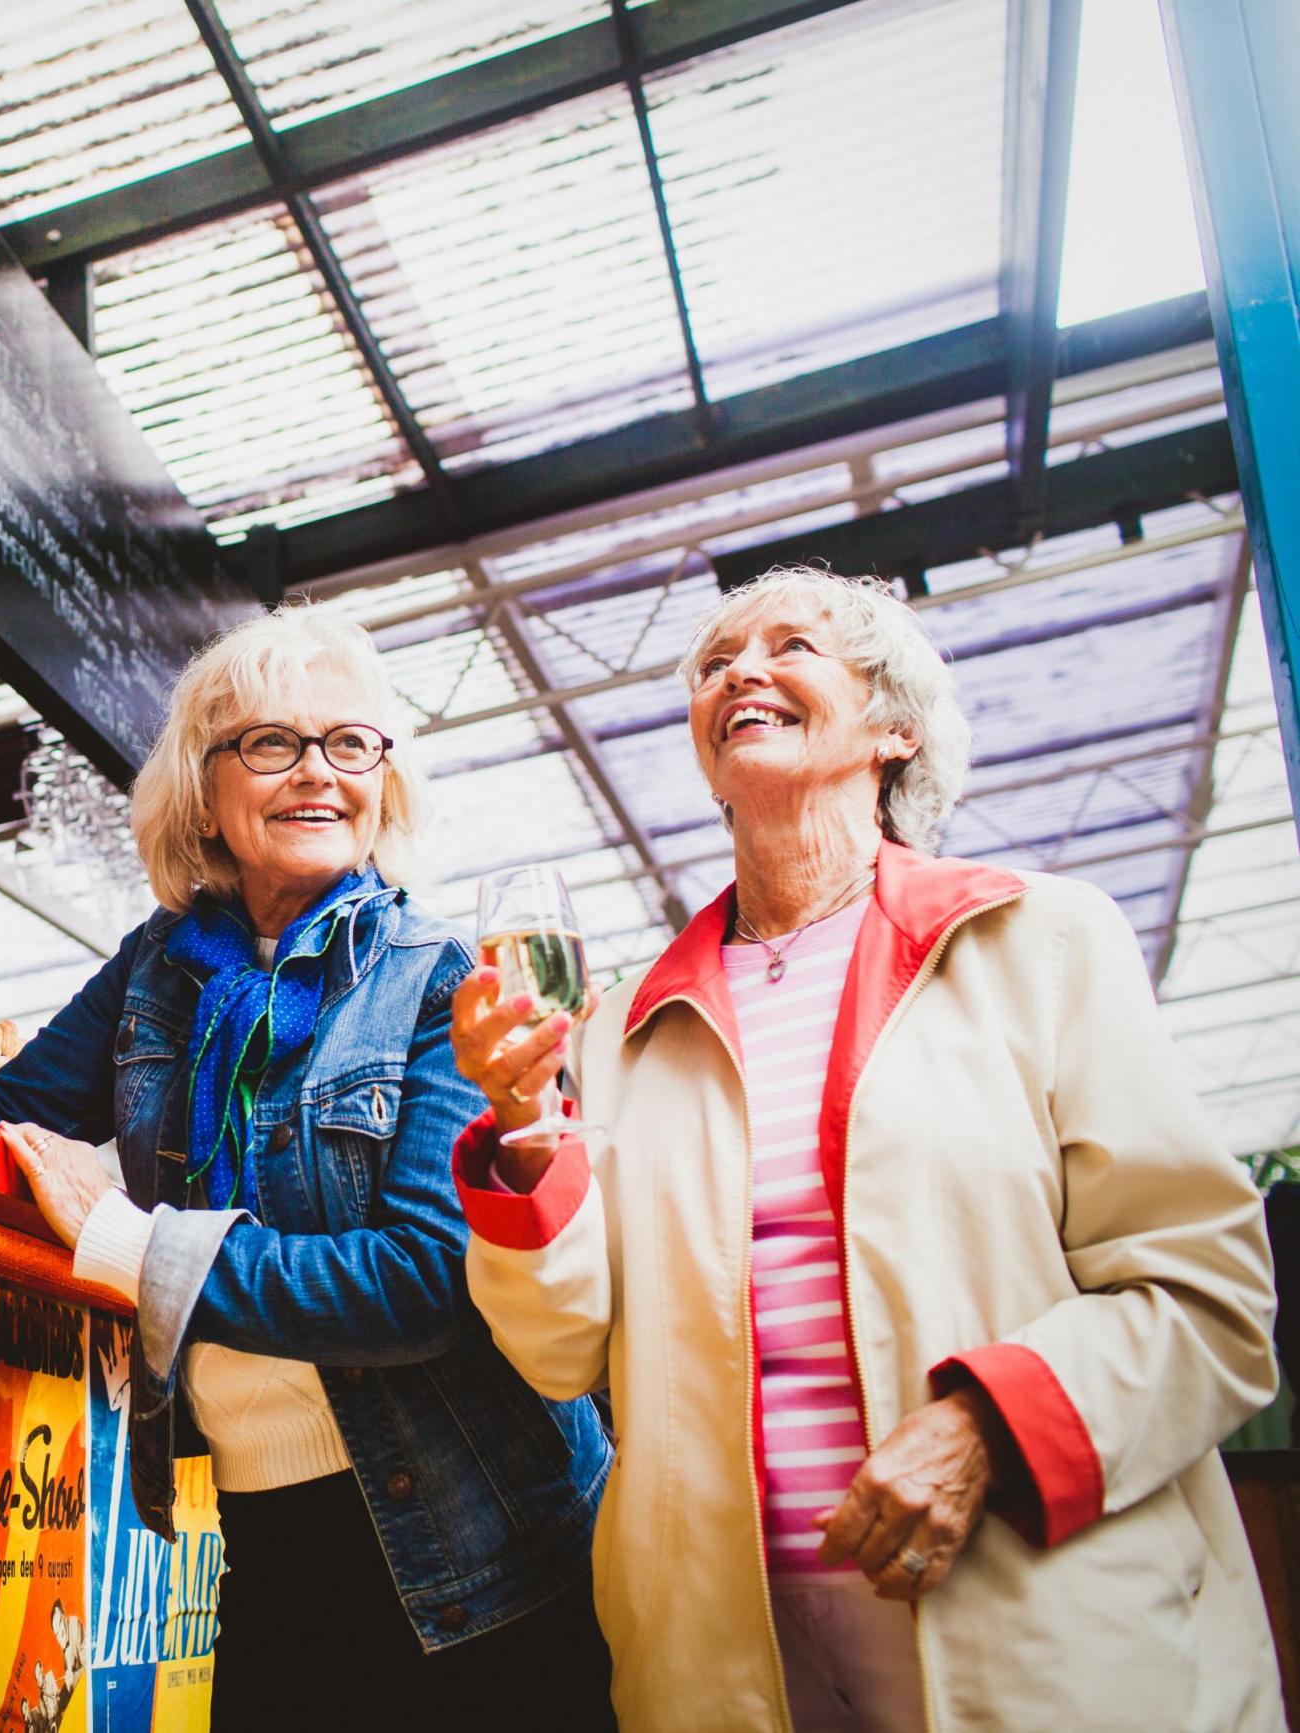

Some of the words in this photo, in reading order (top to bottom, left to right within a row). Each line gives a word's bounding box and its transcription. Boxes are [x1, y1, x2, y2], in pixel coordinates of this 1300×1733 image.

[20, 1550, 34, 1578] den
[38, 1553, 44, 1577] 9
[47, 1555, 74, 1586] augusti
